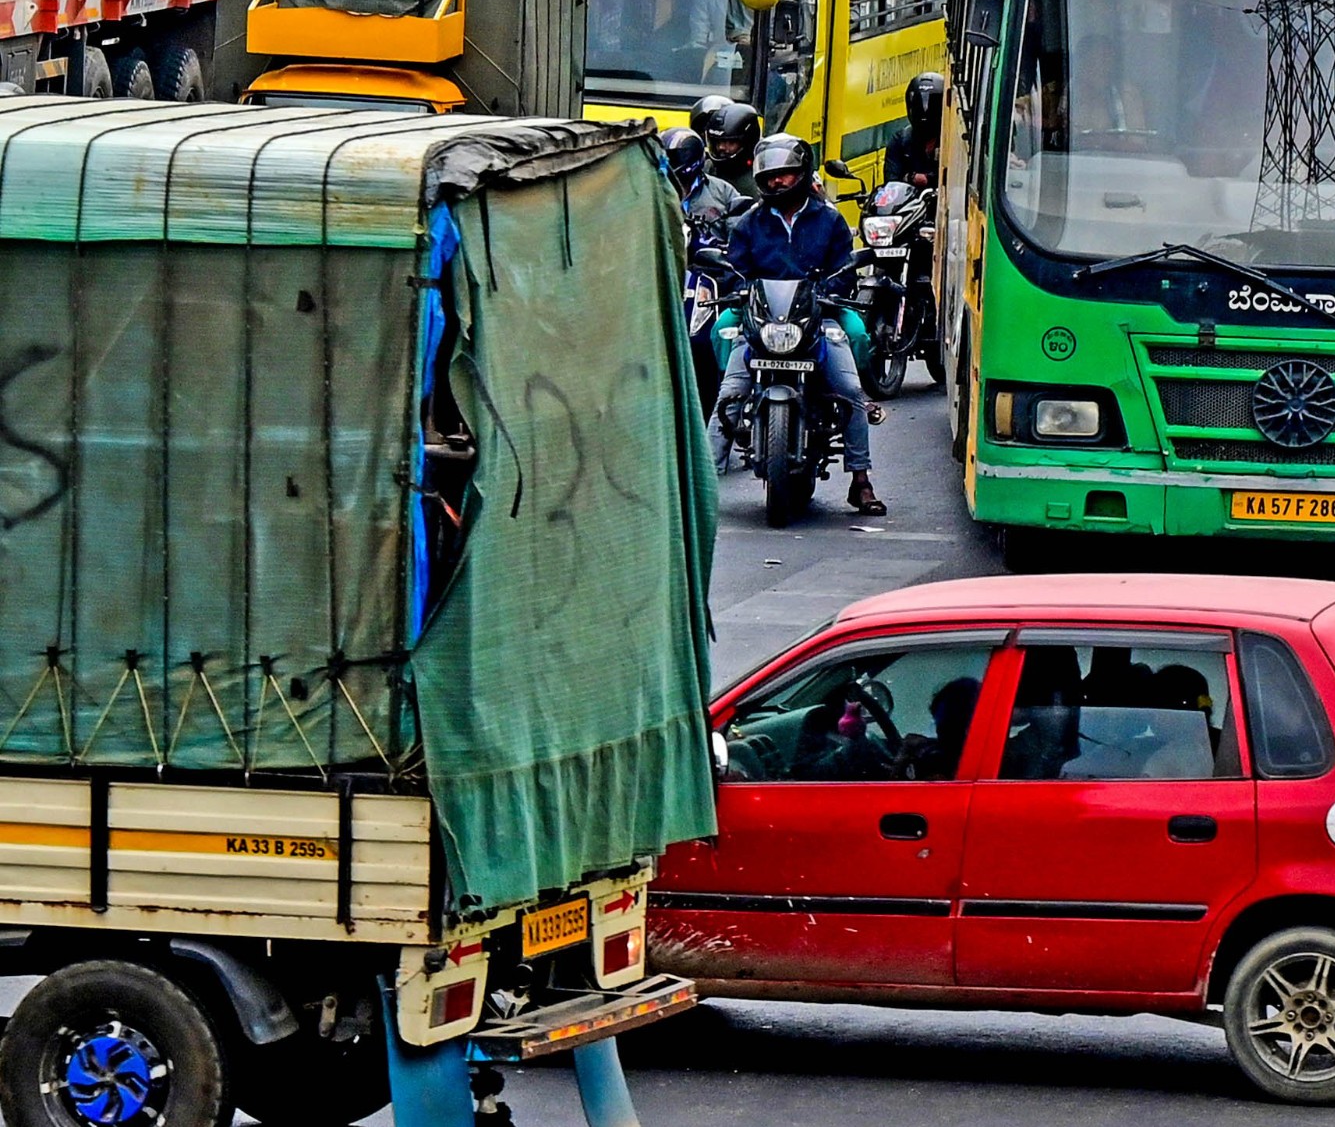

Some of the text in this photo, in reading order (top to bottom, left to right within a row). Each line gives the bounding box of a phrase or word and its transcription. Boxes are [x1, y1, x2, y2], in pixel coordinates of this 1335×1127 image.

[1246, 496, 1266, 515] KA
[1271, 497, 1292, 516] 57
[1295, 499, 1305, 516] F
[226, 837, 248, 854] KA
[251, 838, 269, 855] 33
[274, 840, 285, 856] B
